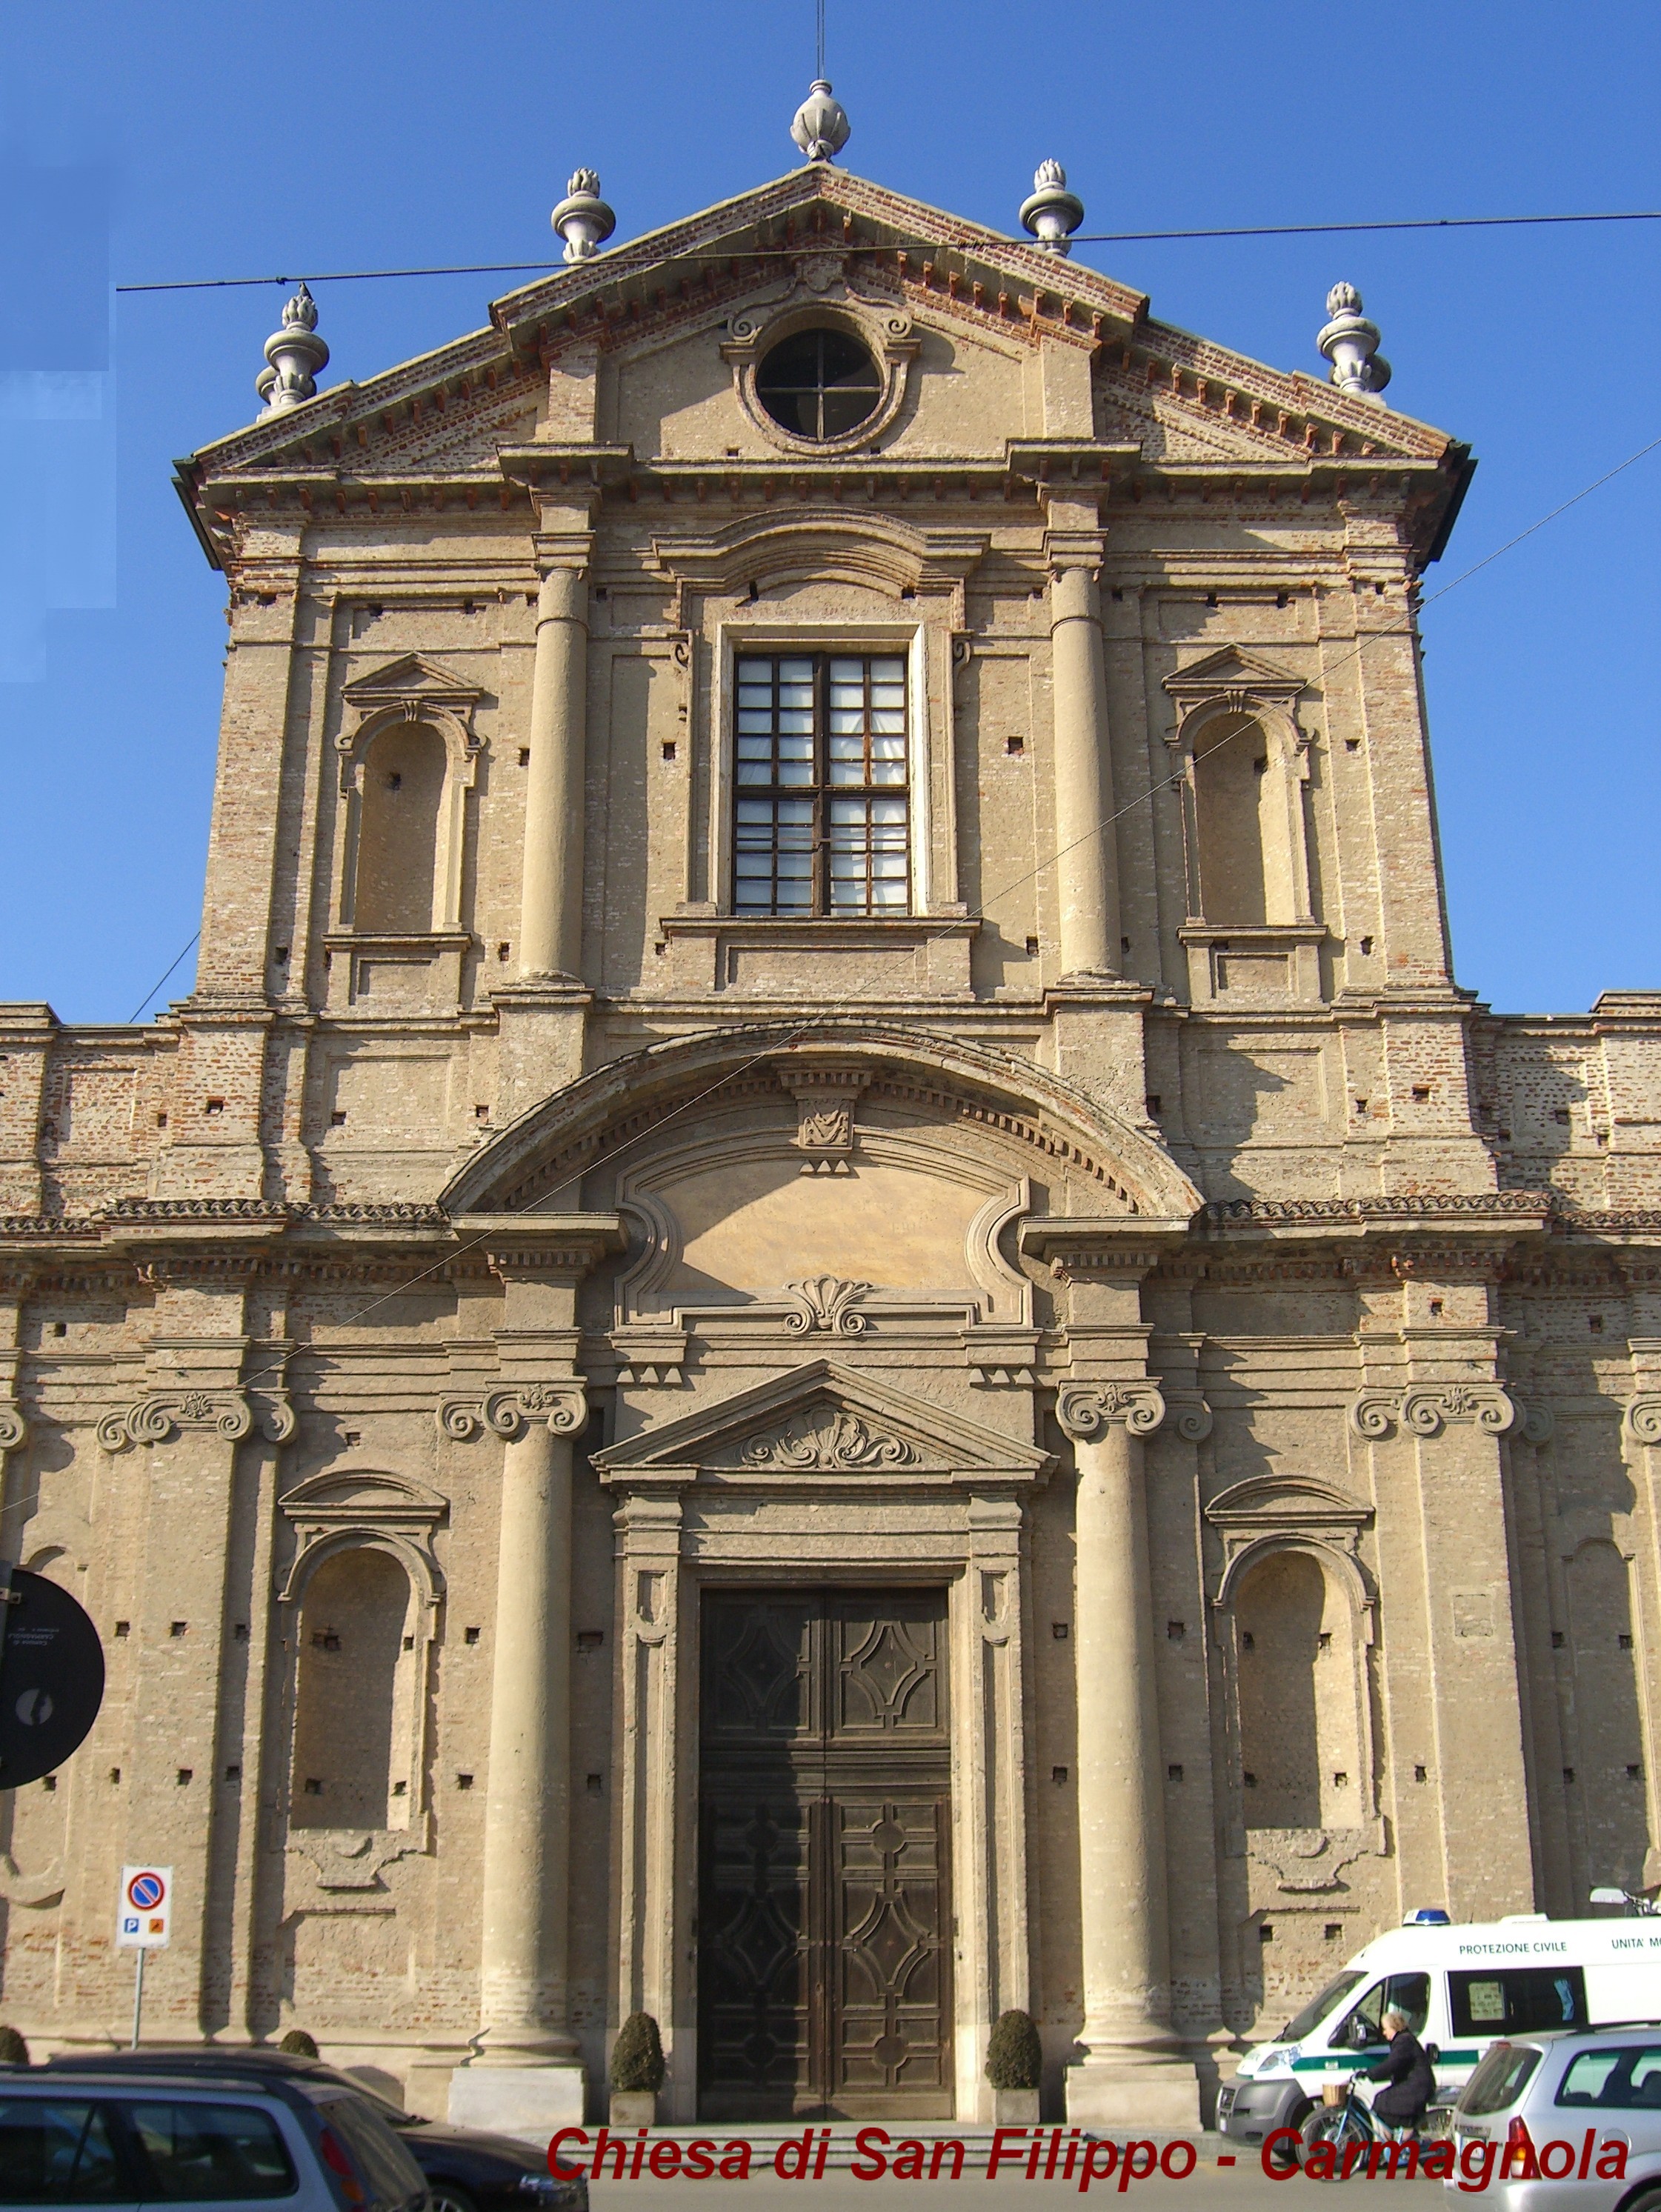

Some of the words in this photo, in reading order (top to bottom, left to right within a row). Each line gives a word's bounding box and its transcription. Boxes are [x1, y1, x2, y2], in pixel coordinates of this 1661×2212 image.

[127, 1919, 138, 1933] P
[1459, 1942, 1530, 1955] PROTEZIONE
[1533, 1941, 1568, 1953] CIVILE
[1649, 1936, 1661, 1948] M
